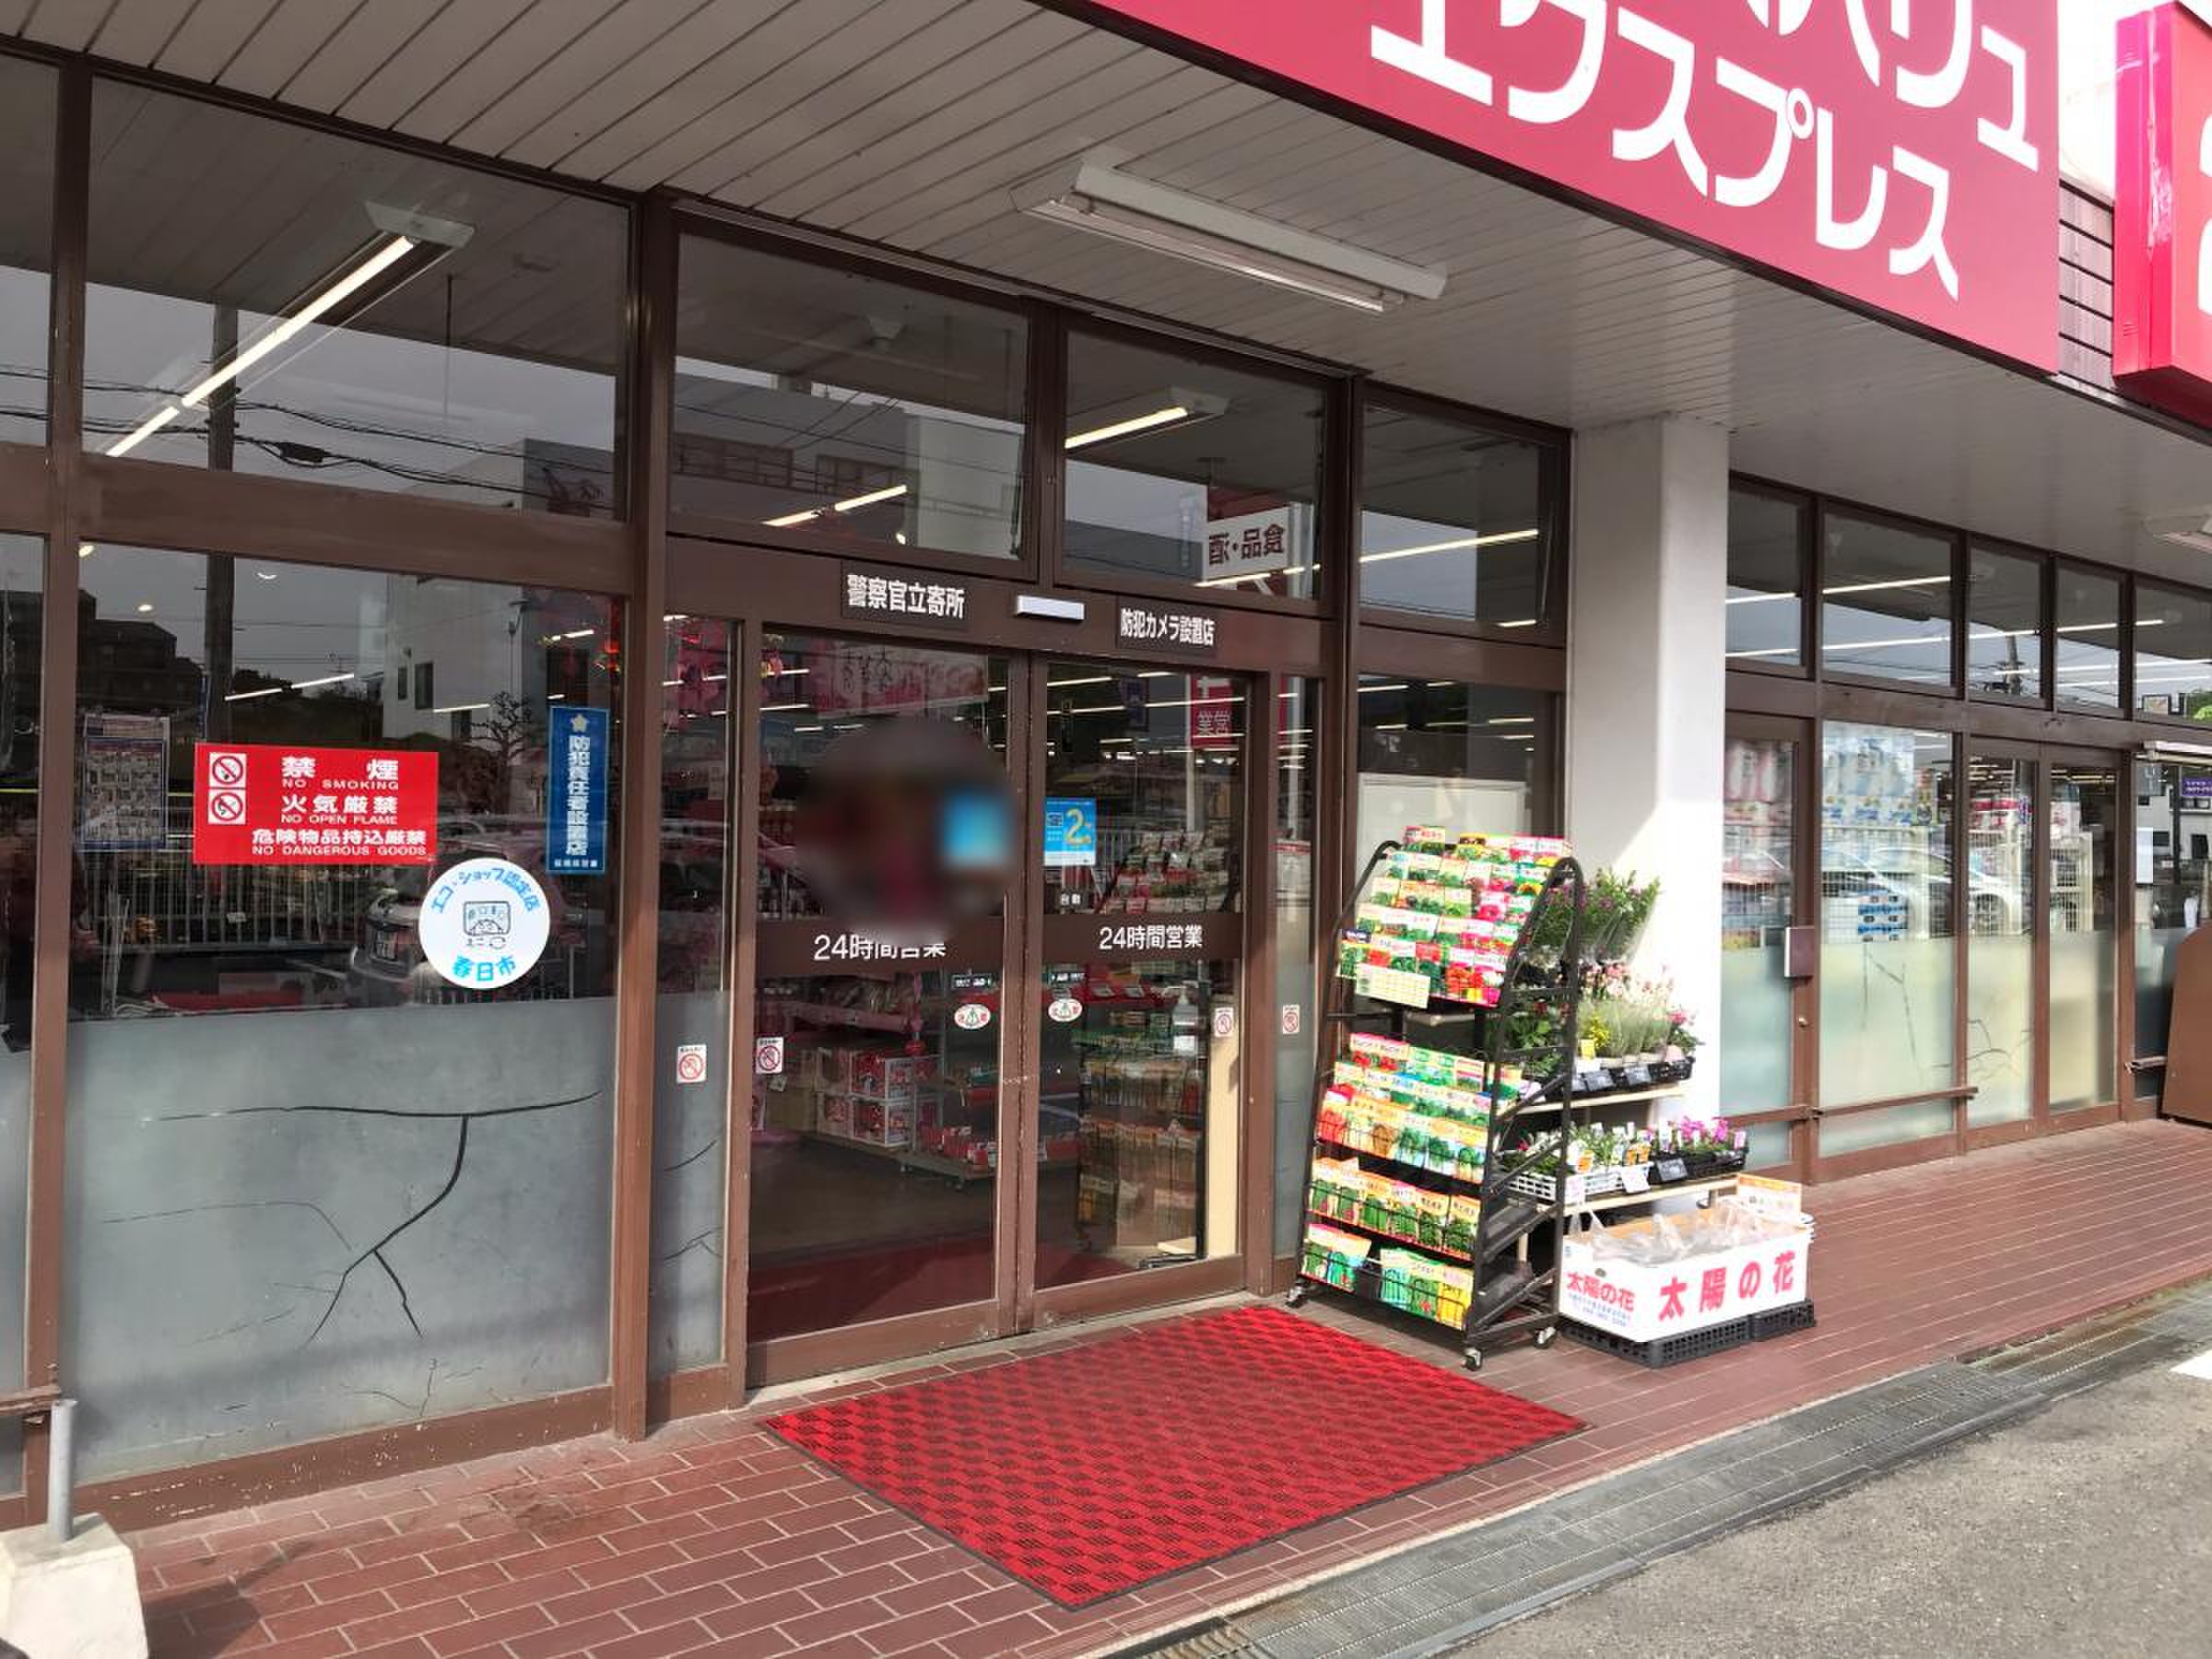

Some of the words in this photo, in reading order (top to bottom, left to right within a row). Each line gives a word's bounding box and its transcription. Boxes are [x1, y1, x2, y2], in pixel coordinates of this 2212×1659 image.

[846, 573, 966, 619] 警察官立寄所
[1120, 607, 1216, 646] 防犯カメラ設置店
[282, 780, 307, 789] NO
[323, 781, 399, 790] SMOKING
[281, 794, 398, 815] 火気厳禁
[281, 815, 302, 824] NO
[309, 815, 347, 825] OPEN
[353, 816, 398, 825] FLAME
[252, 829, 427, 845] 危険物品持込厳禁
[252, 845, 274, 856] NO
[282, 845, 370, 856] DANGEROUS
[377, 845, 427, 856] GOODS
[1100, 924, 1203, 950] 24時間営業
[453, 954, 516, 982] 春日市
[1567, 1271, 1636, 1312] 太陽の花
[1659, 1250, 1796, 1322] 太陽の花
